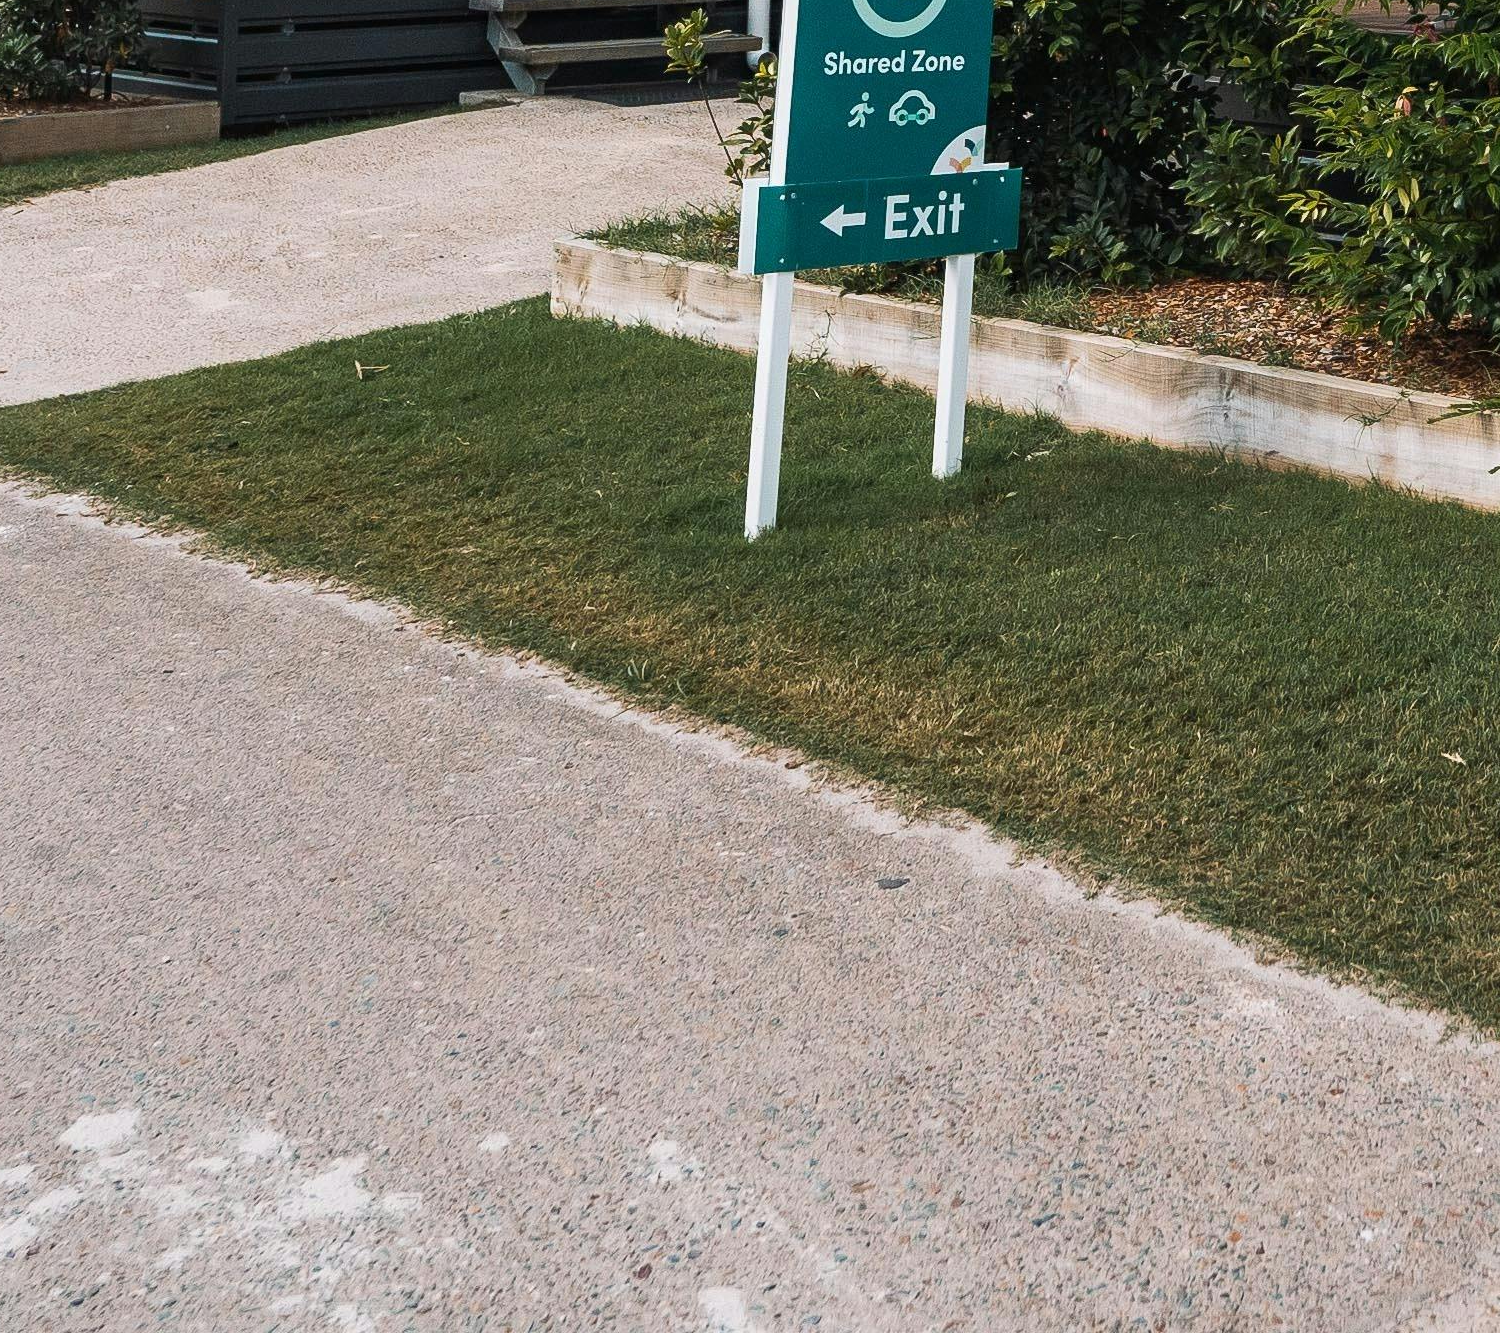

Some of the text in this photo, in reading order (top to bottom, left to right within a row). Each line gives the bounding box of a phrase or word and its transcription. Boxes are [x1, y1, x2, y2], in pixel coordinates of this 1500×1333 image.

[823, 49, 966, 76] Shared Zone
[884, 190, 965, 240] Exit
